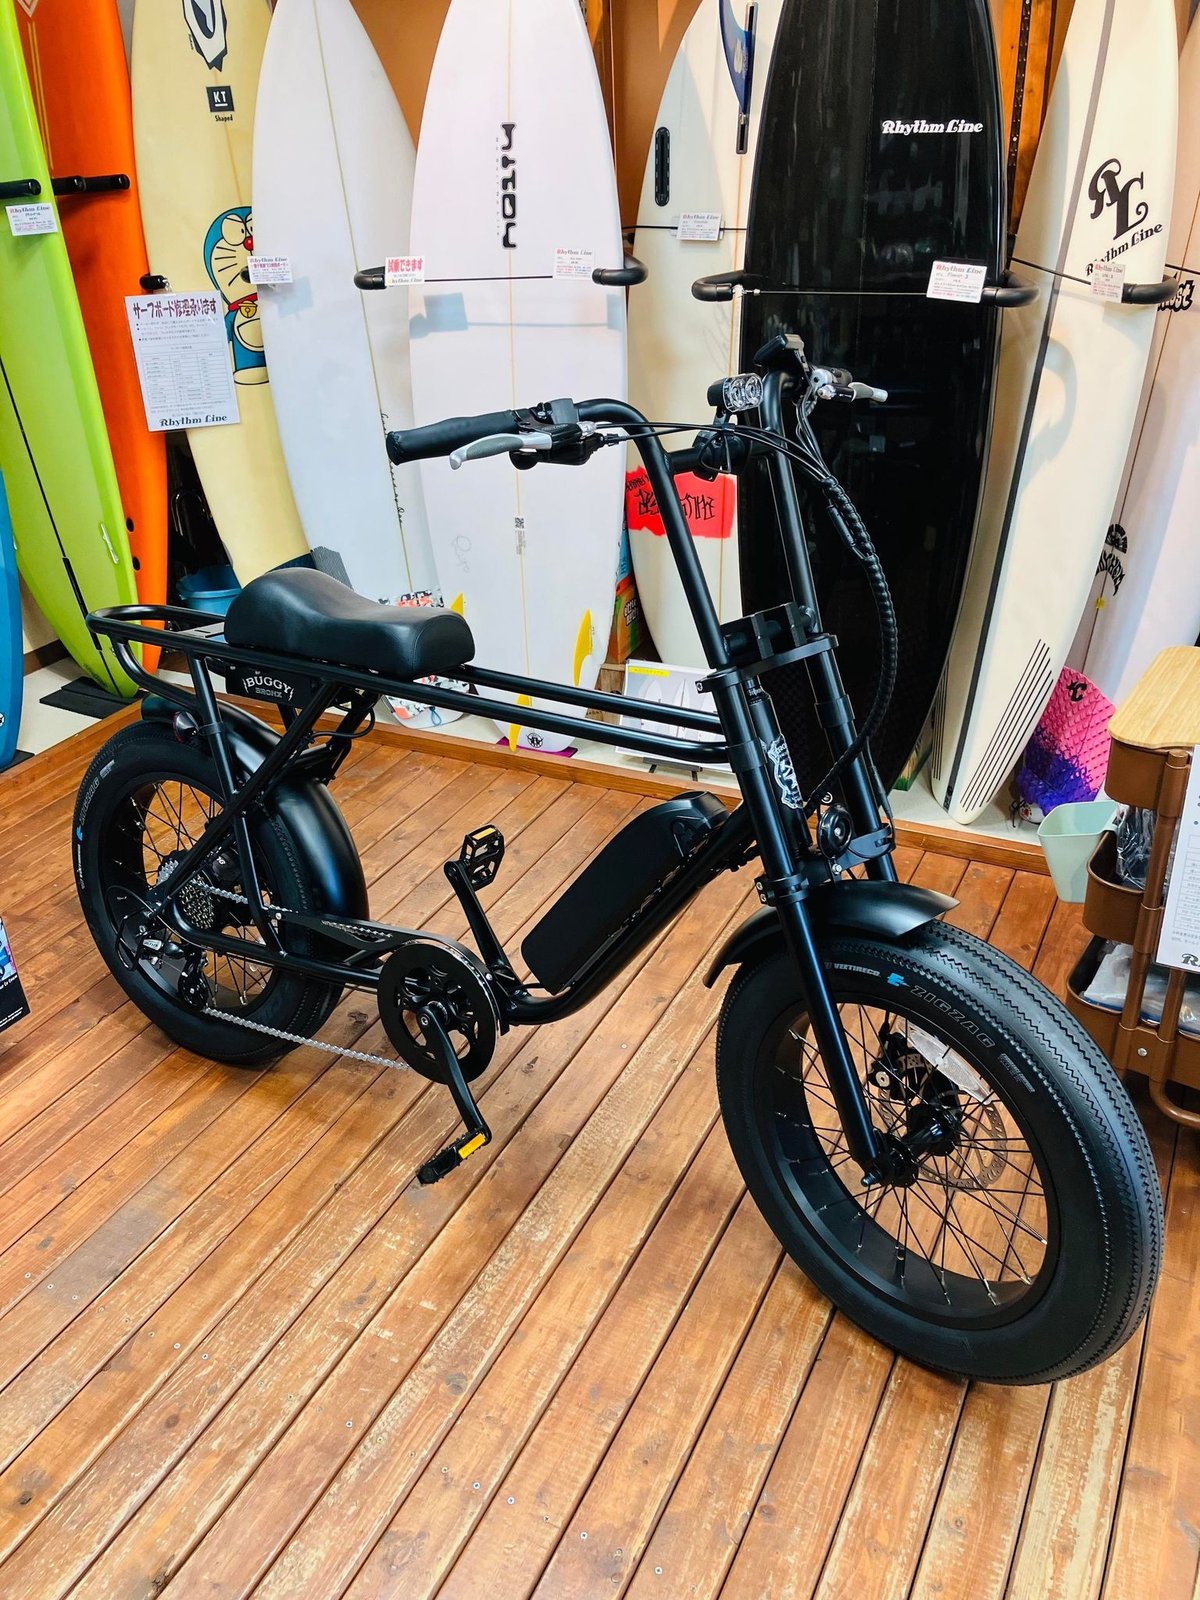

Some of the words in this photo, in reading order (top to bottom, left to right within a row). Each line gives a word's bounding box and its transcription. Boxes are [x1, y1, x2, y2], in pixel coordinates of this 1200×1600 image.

[213, 91, 226, 103] KT
[214, 114, 233, 123] Shaped
[882, 120, 944, 136] Rhythm
[945, 119, 984, 133] Line
[1130, 223, 1163, 248] Line
[160, 416, 202, 427] Rhythm
[205, 414, 227, 423] Line
[245, 676, 292, 694] BUGGY
[909, 985, 996, 1048] ZIGZAG
